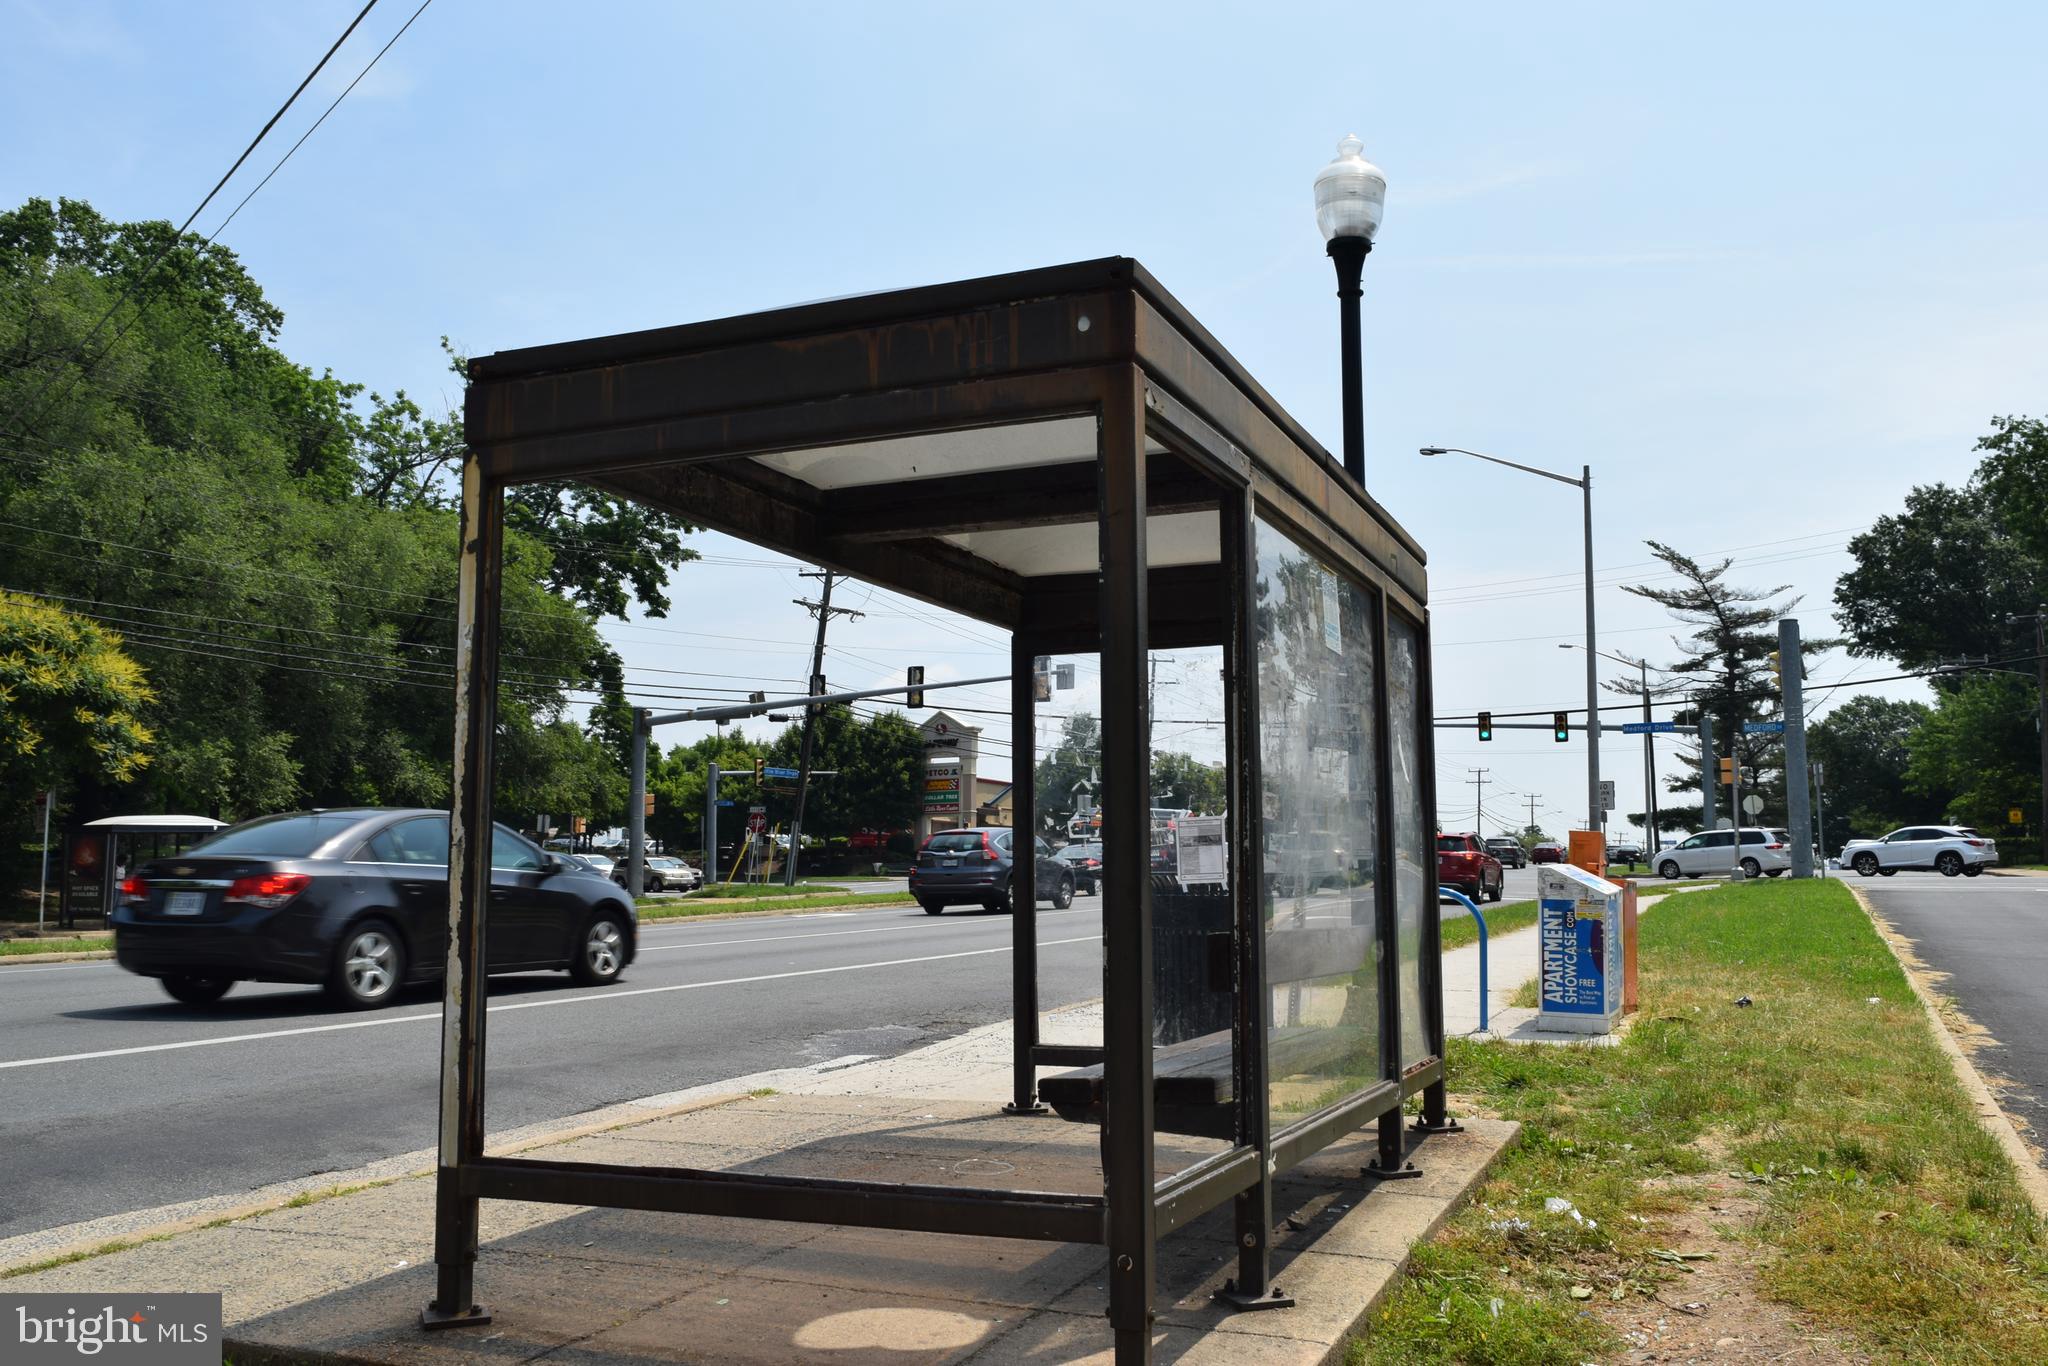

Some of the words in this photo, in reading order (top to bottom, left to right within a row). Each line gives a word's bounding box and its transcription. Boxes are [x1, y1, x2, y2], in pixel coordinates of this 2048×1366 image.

[1623, 724, 1651, 733] Medford
[1654, 723, 1673, 731] Drive
[1744, 723, 1776, 732] MEDFORD
[748, 818, 765, 827] STOP
[1544, 908, 1563, 1003] APARTMENT
[1579, 978, 1597, 987] FREE
